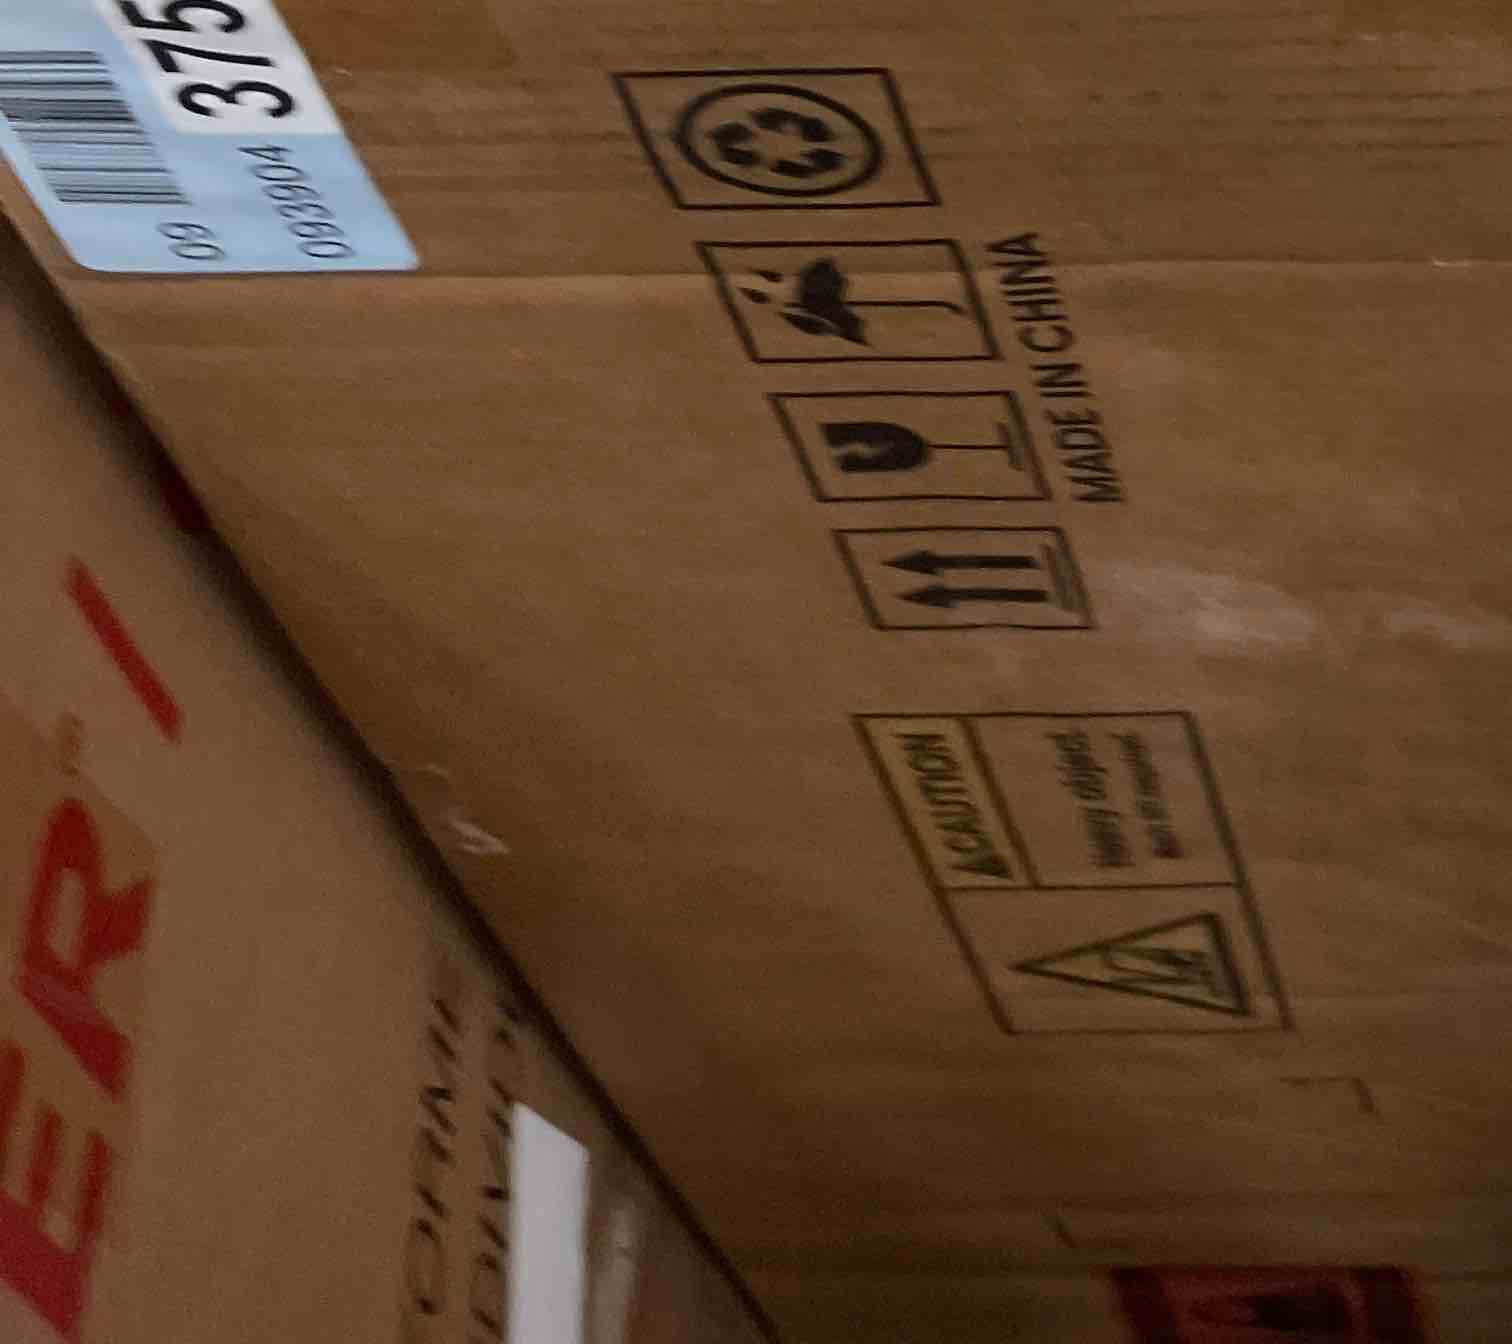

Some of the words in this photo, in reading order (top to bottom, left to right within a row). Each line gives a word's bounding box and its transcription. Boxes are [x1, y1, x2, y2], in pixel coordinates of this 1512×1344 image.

[158, 221, 226, 261] 09
[237, 144, 356, 261] 093904
[985, 232, 1075, 353] CHINA
[1031, 361, 1088, 401] IN
[1046, 409, 1125, 505] MADE
[894, 731, 988, 853] CAUTION
